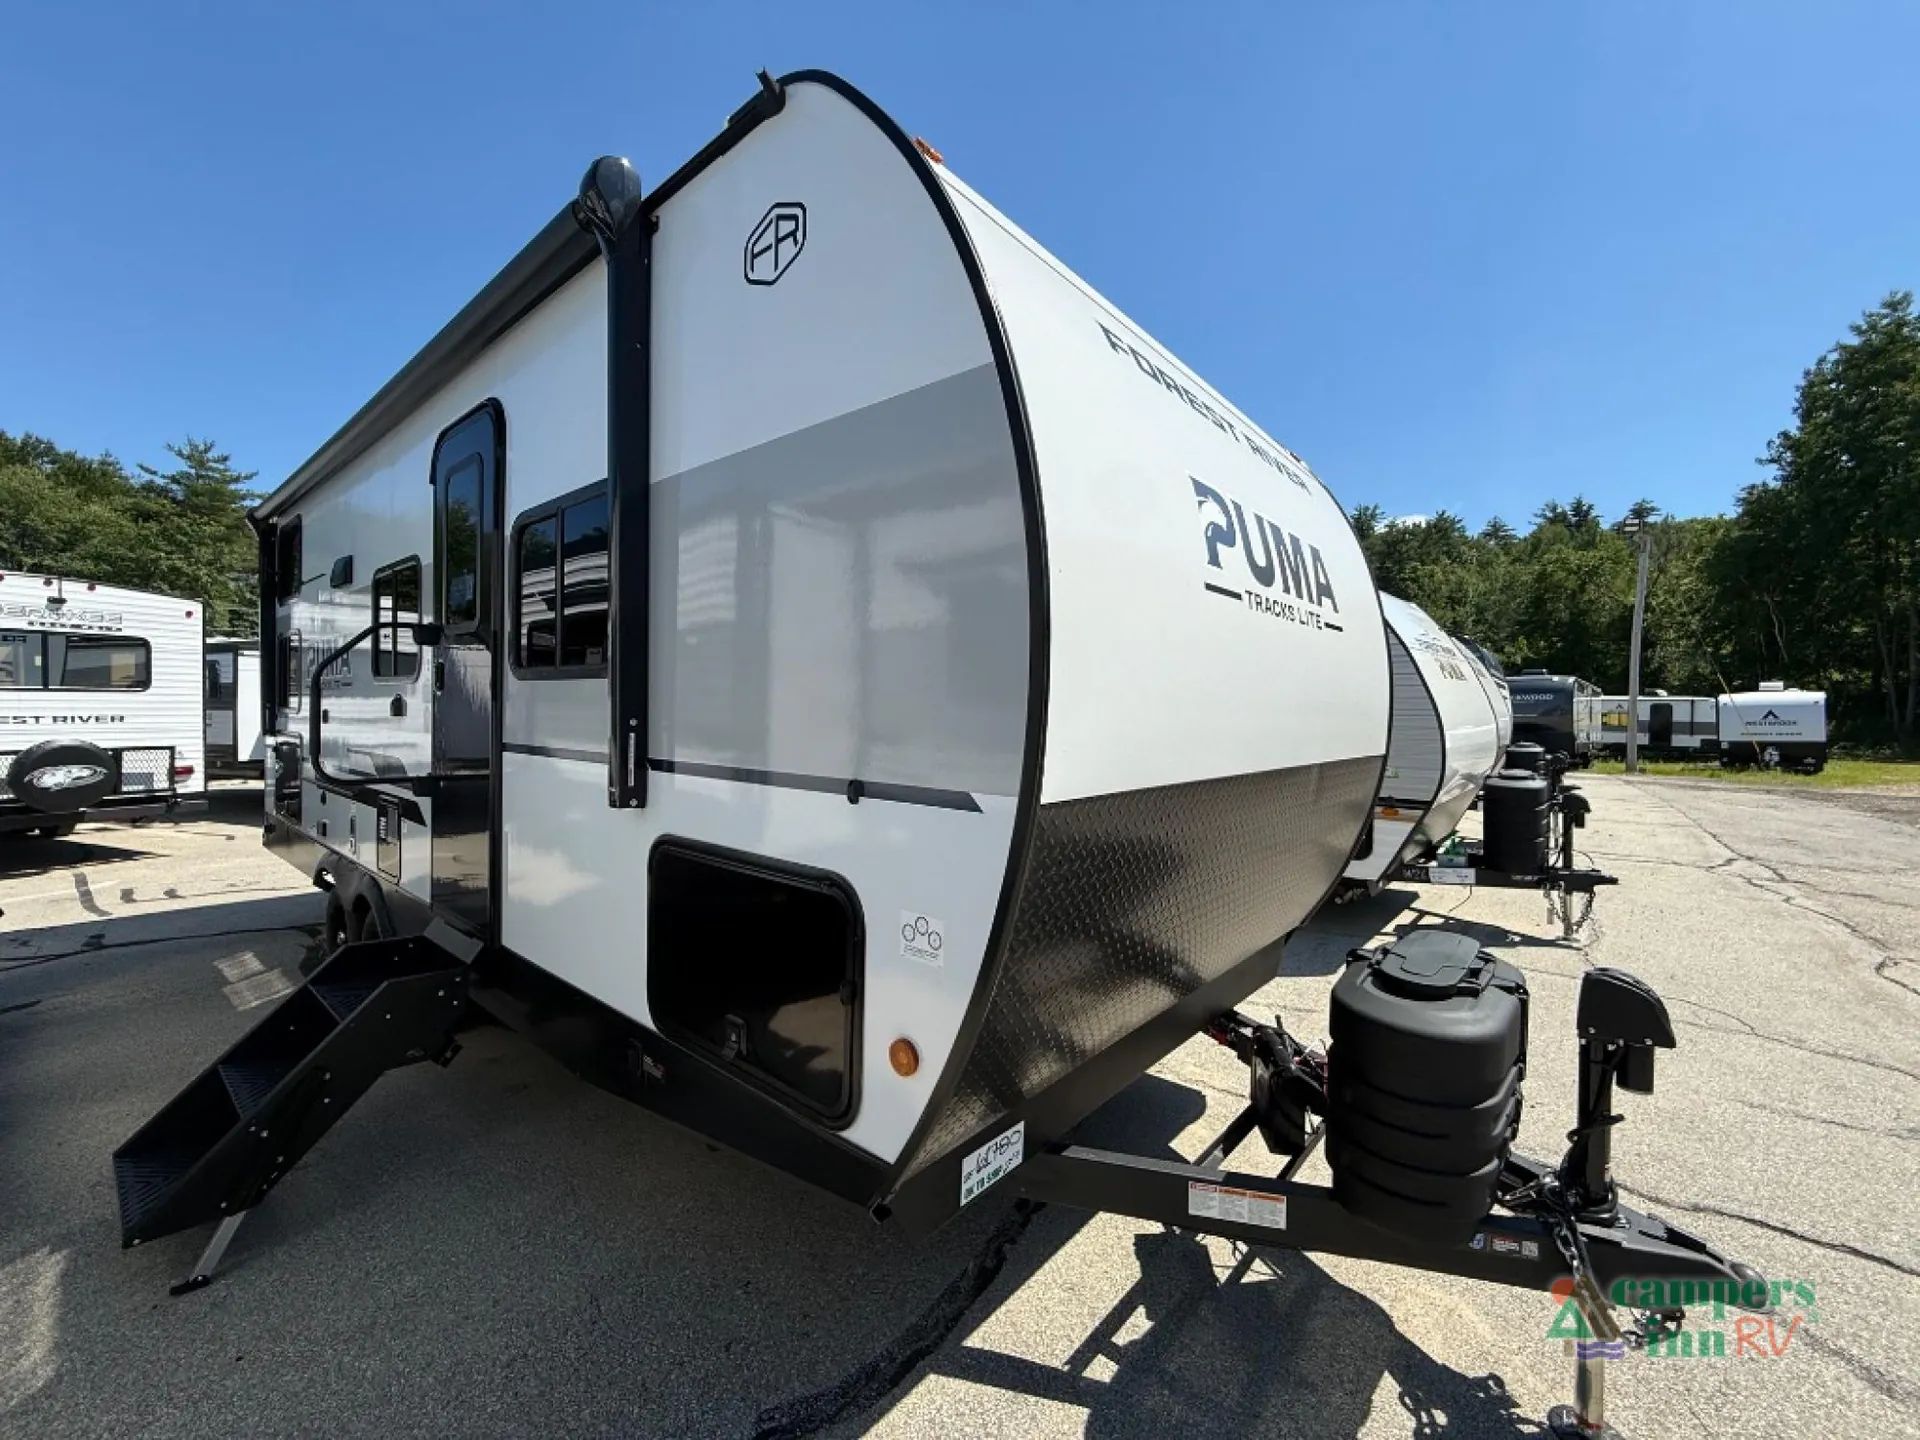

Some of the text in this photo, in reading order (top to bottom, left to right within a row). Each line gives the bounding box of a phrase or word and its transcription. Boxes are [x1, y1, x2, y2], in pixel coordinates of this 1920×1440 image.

[1096, 319, 1240, 442] FOREST
[1189, 474, 1339, 613] PUMA
[1245, 590, 1323, 631] TRACKS LITE
[52, 715, 124, 723] RIVER
